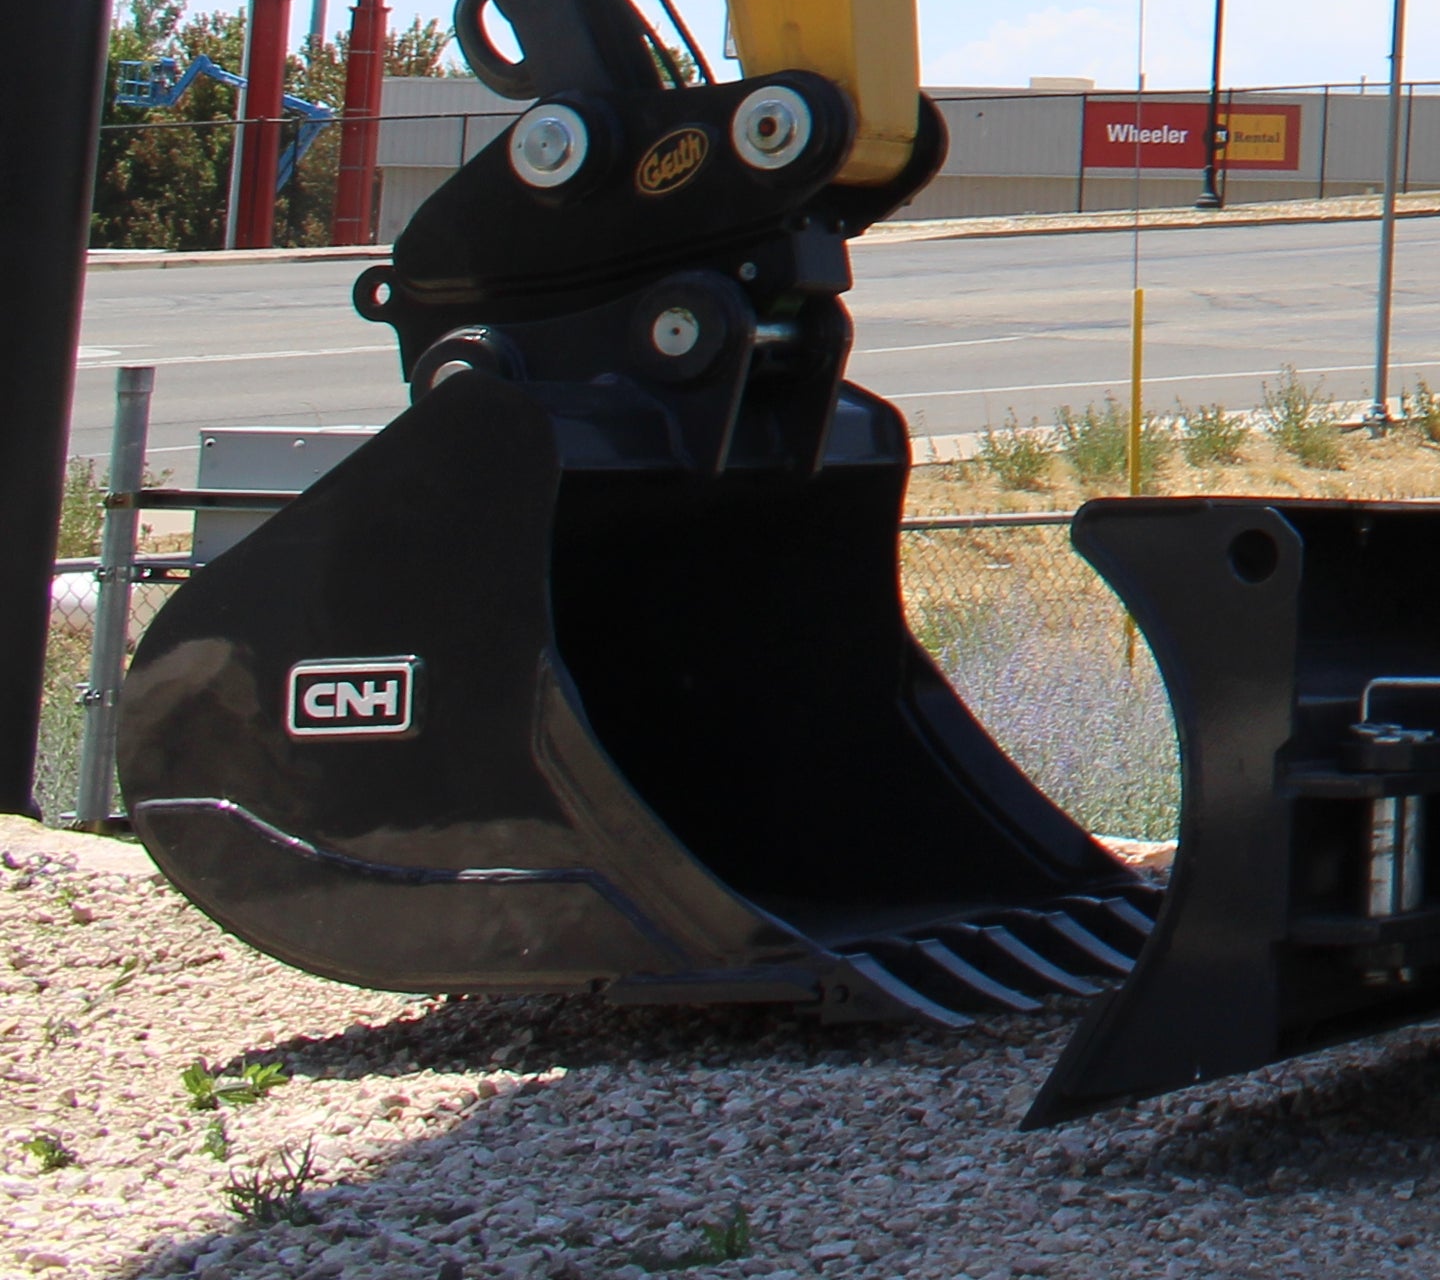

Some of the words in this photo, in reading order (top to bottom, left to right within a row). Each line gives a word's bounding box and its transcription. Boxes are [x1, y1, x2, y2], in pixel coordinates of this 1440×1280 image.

[1106, 124, 1189, 144] Wheeler
[1233, 131, 1280, 144] Rental
[303, 679, 399, 718] CNH
